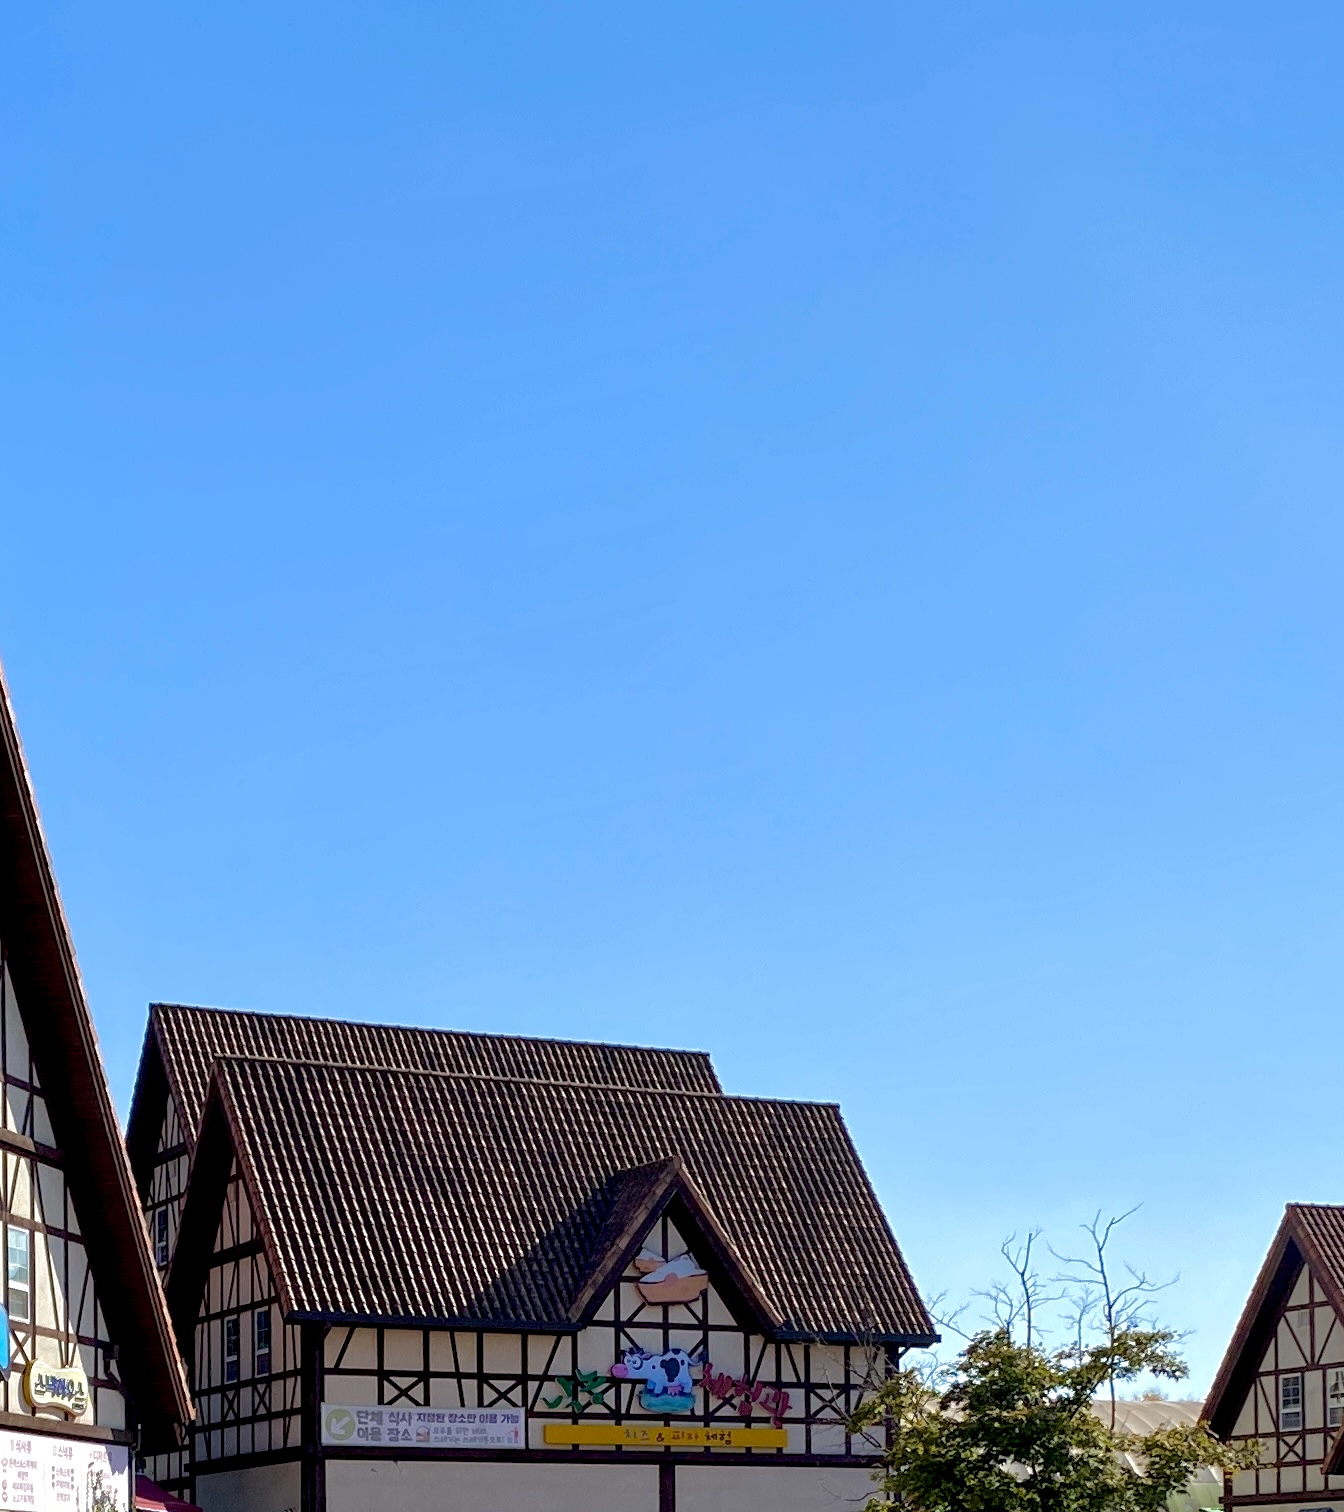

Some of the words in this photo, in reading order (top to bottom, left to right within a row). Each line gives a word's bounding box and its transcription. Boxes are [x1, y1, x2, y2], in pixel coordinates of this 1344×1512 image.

[34, 1373, 87, 1402] 스낵하우스
[357, 1410, 383, 1426] 단체
[388, 1411, 413, 1426] 식사
[448, 1413, 476, 1424] 장소만
[357, 1427, 382, 1441] 이용
[387, 1427, 413, 1442] 장소
[624, 1429, 650, 1441] 치즈
[656, 1433, 665, 1442] &
[672, 1431, 699, 1440] 피자
[704, 1430, 732, 1445] 체험
